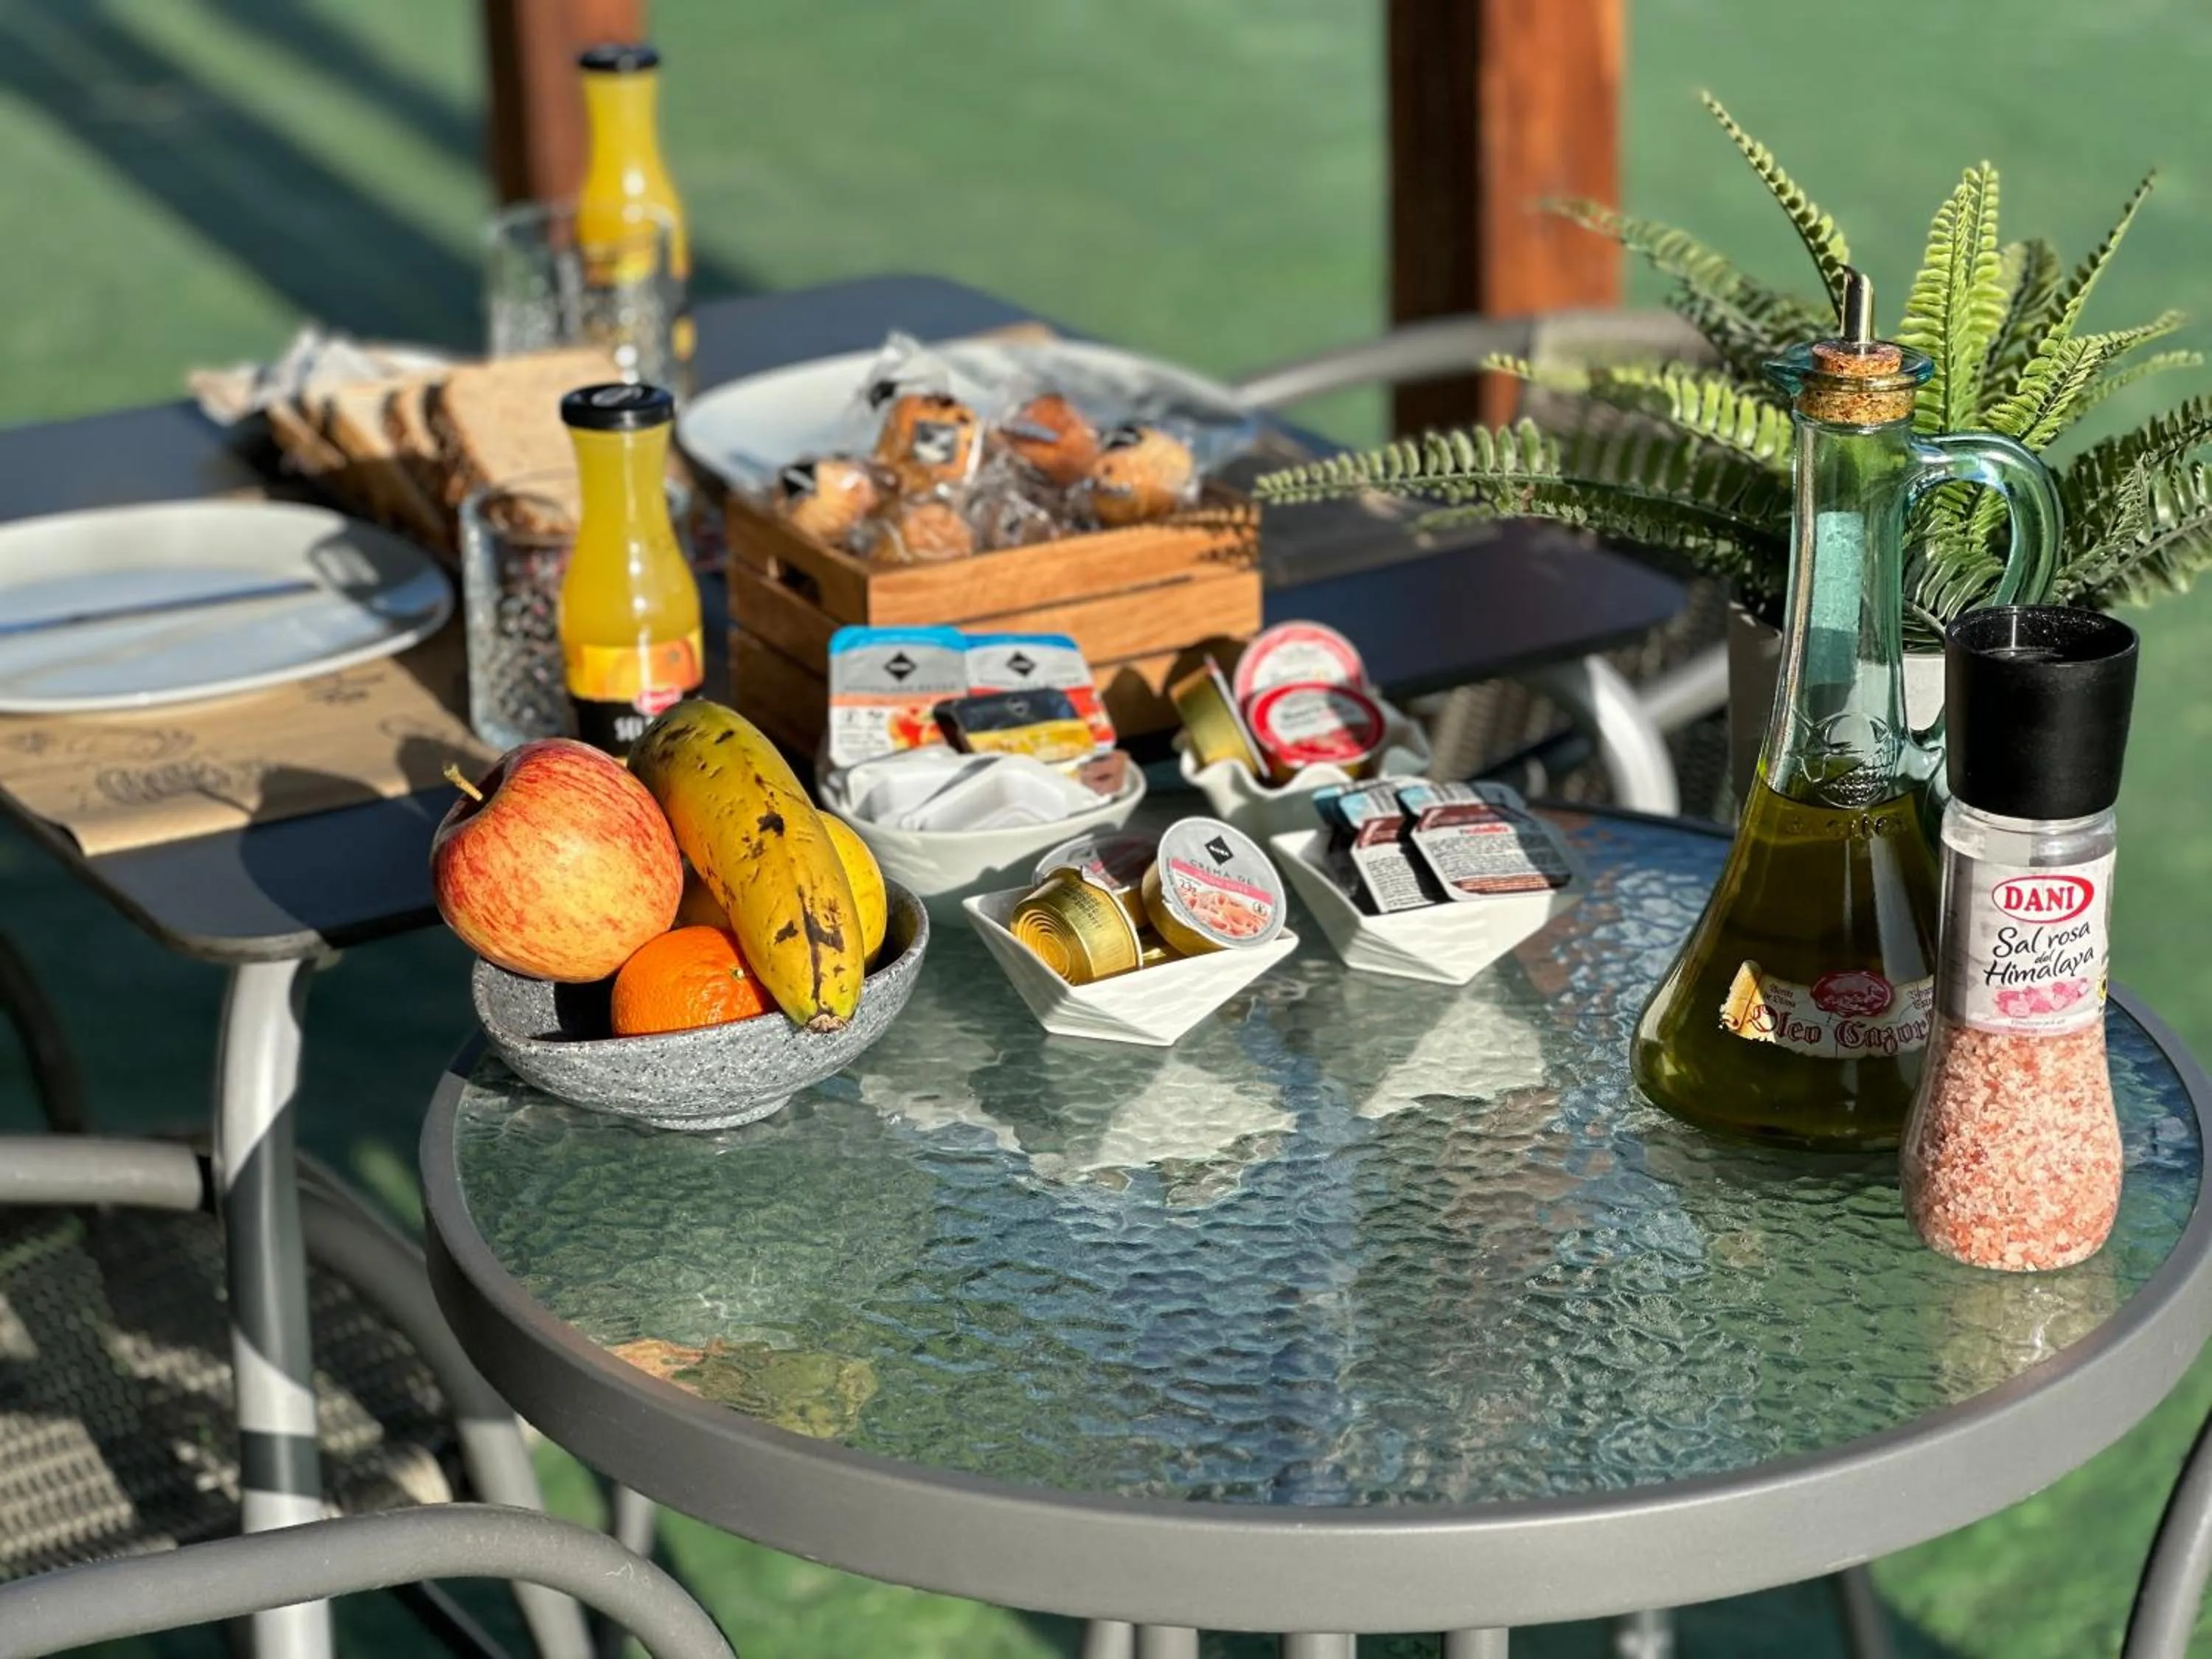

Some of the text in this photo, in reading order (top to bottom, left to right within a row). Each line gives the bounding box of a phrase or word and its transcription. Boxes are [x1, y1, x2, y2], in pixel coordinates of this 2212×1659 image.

[2003, 886, 2075, 911] DANI
[1992, 922, 2091, 958] Sal rosa
[2034, 949, 2054, 964] del
[1983, 947, 2094, 987] Himalaya
[1747, 1004, 1933, 1054] Oleo Cazor
